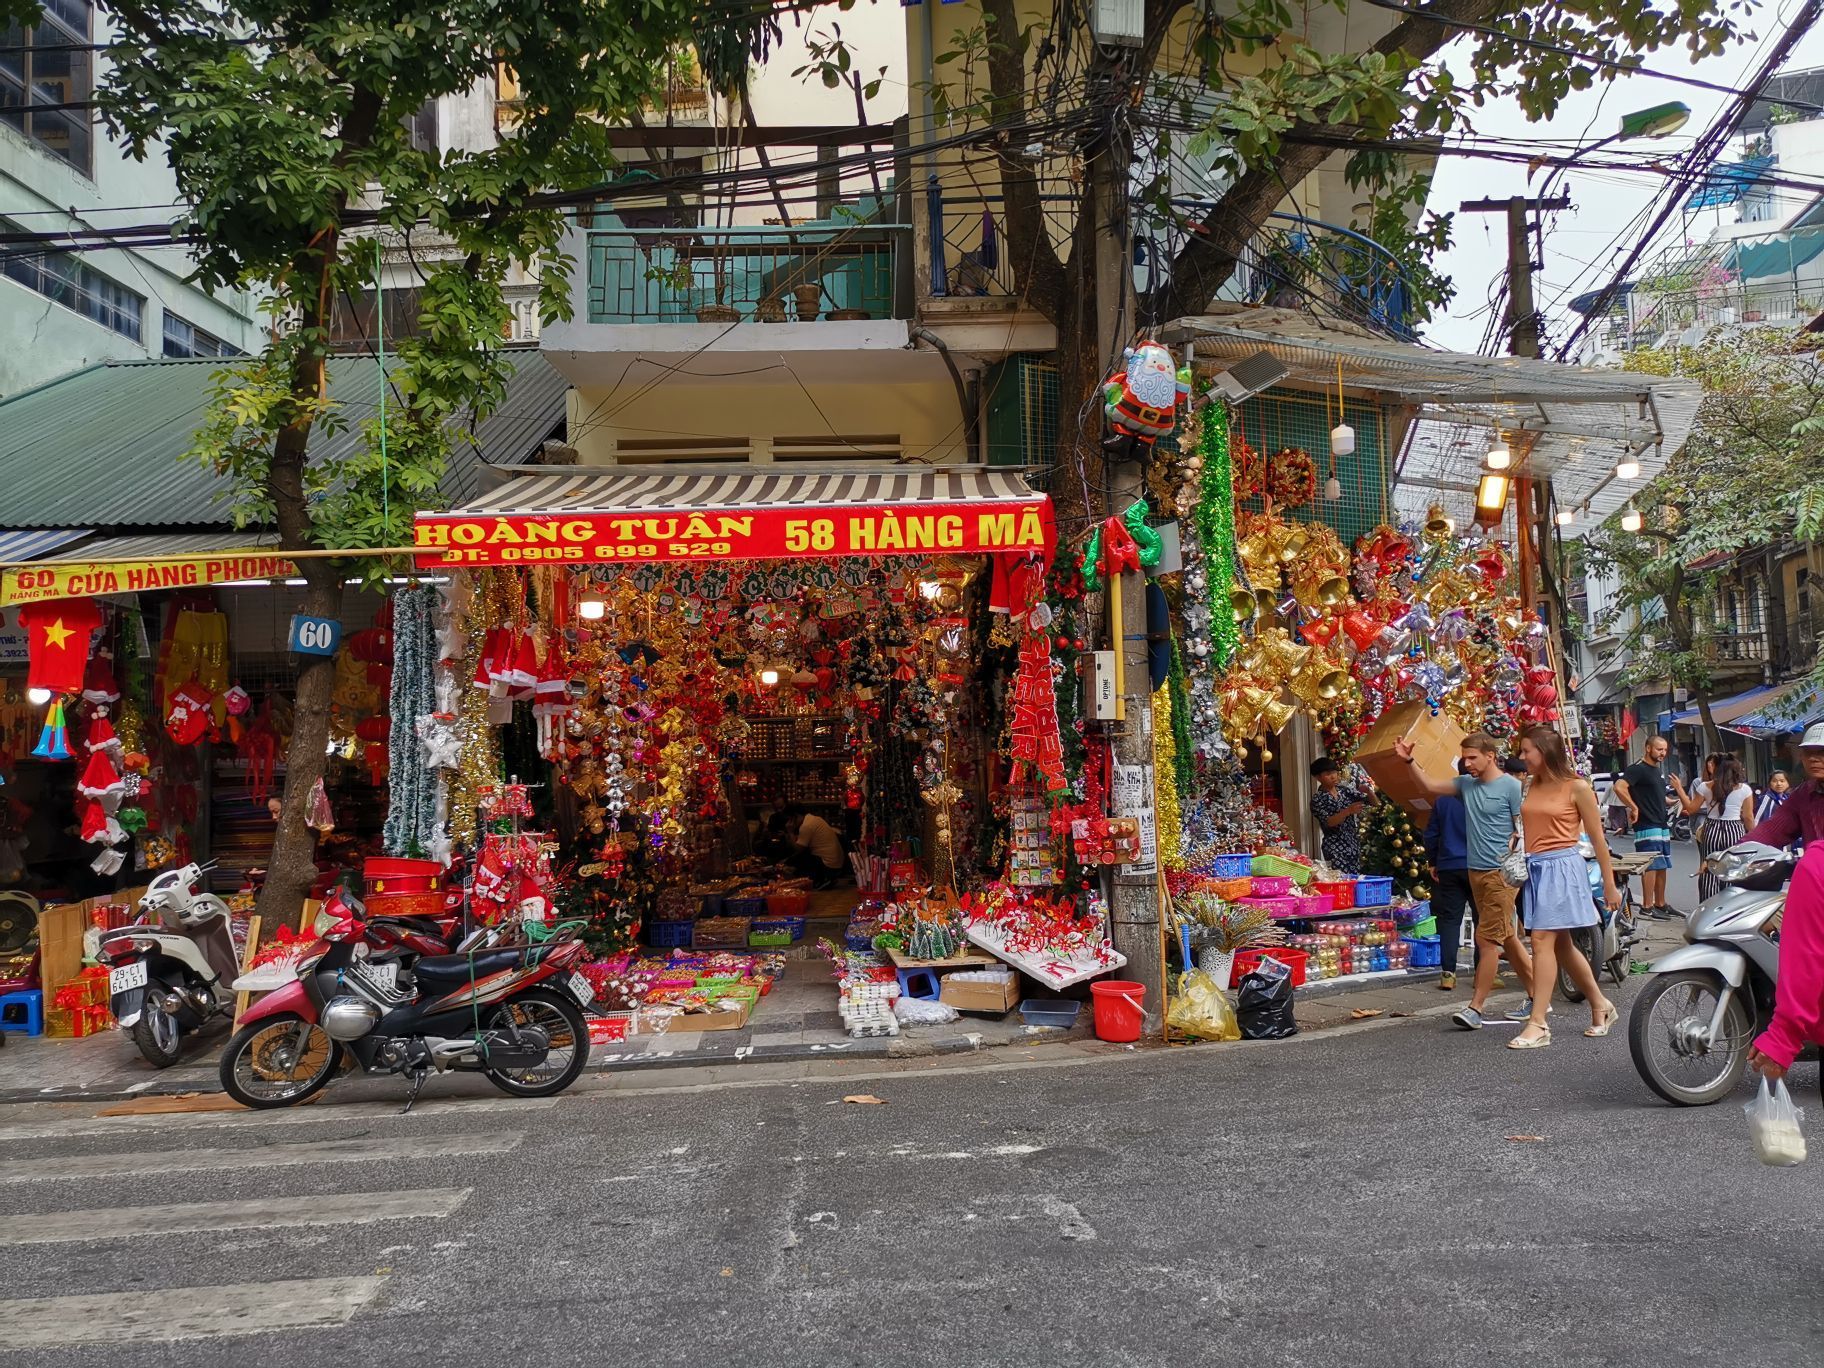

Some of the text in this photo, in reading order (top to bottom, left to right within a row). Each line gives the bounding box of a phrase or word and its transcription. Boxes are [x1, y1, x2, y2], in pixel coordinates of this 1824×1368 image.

[414, 517, 597, 546] HOÀNG
[785, 519, 835, 552] 58
[849, 510, 963, 551] HÀNG
[978, 506, 1044, 546] MÃ
[501, 546, 584, 561] 0905
[594, 544, 657, 558] 699
[668, 542, 731, 556] 529
[17, 569, 55, 590] 60
[66, 563, 119, 595] CỬA
[127, 563, 197, 590] HÀNG
[299, 621, 332, 649] 60
[115, 965, 140, 981] 29-C1
[112, 975, 143, 993] 641.51
